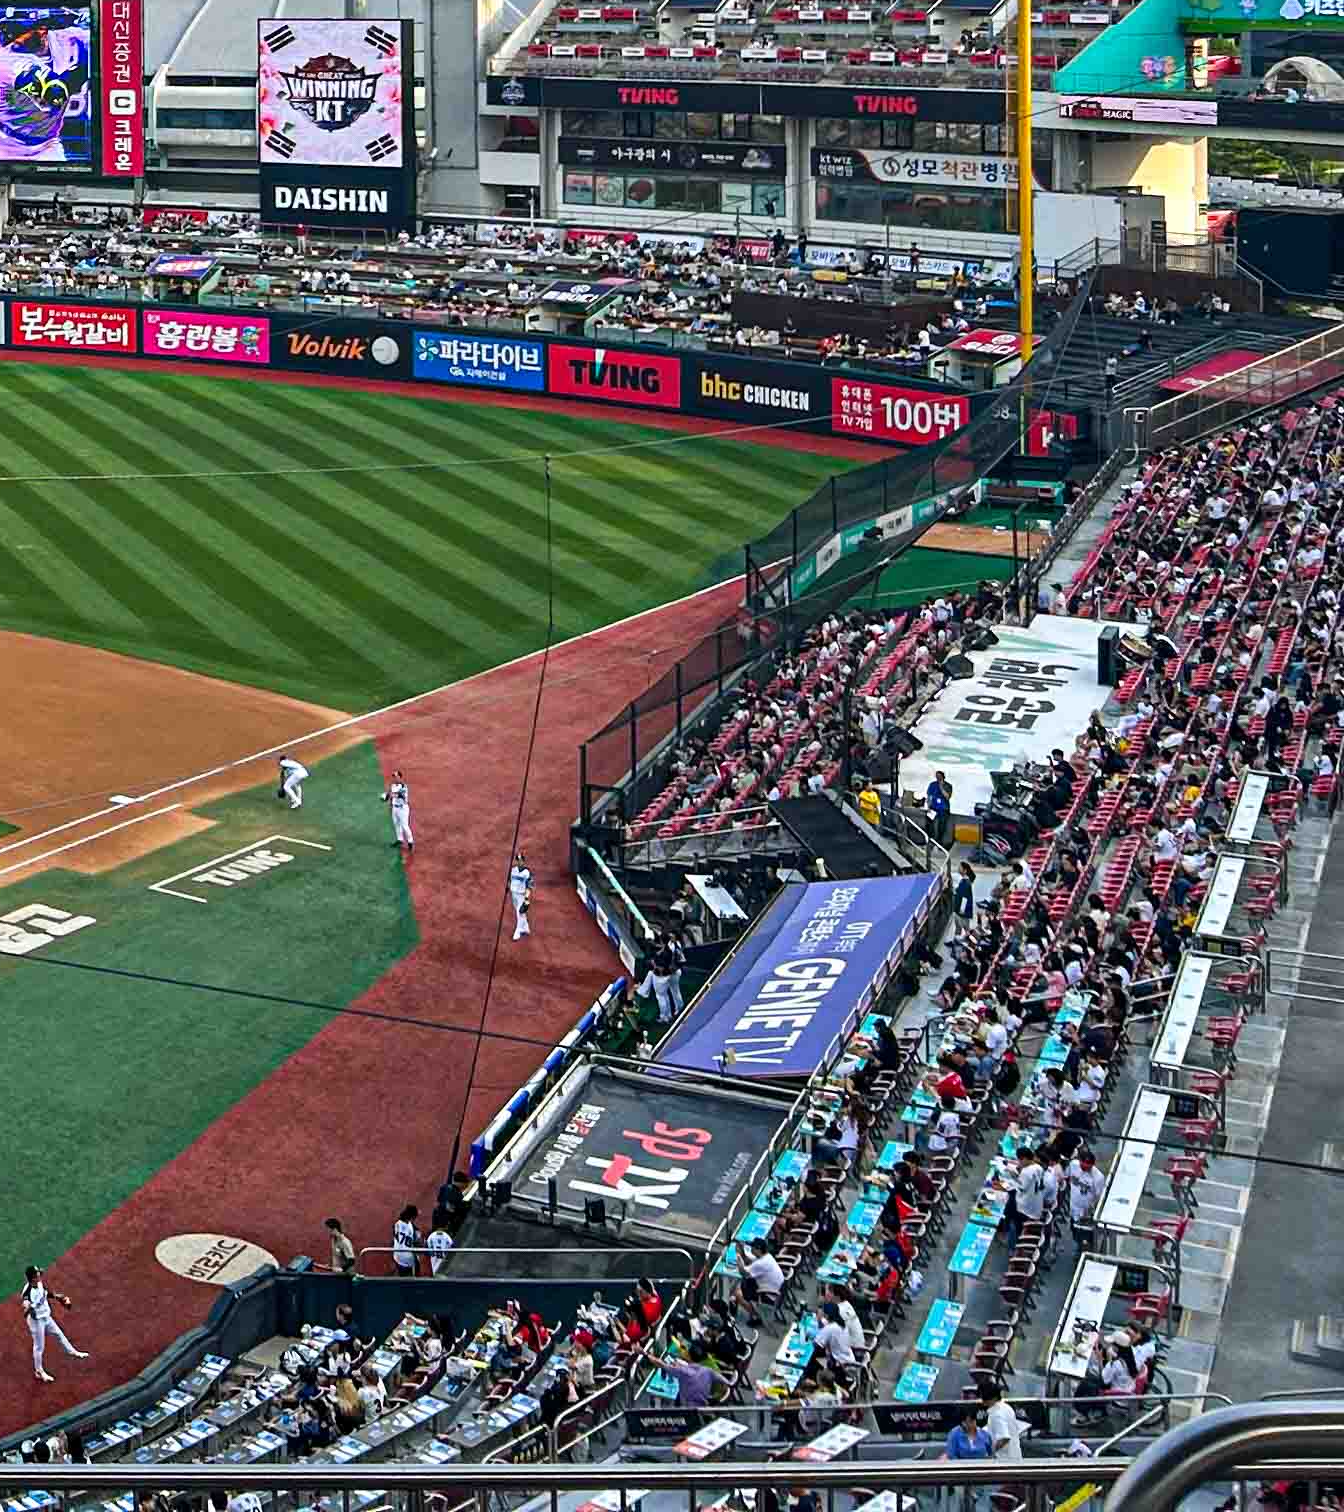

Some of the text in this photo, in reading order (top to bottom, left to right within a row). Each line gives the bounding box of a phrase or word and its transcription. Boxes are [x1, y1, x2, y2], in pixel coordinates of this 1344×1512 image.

[112, 1, 132, 84] 대신증권
[288, 78, 376, 98] WINNING
[618, 88, 680, 105] TVING
[853, 95, 917, 113] TVING
[315, 101, 345, 121] KT
[275, 186, 388, 213] DAISHIN
[156, 321, 239, 353] 홈런볼
[288, 333, 365, 361] Volvik
[439, 340, 540, 372] 파라다이브
[569, 350, 661, 393] TVING
[701, 372, 809, 411] bhc CHICKEN
[841, 415, 854, 428] TV
[880, 397, 960, 439] 100번
[192, 848, 296, 887] TVING
[734, 958, 848, 1034] GENIE
[622, 1121, 712, 1161] ds
[568, 1153, 689, 1208] kt
